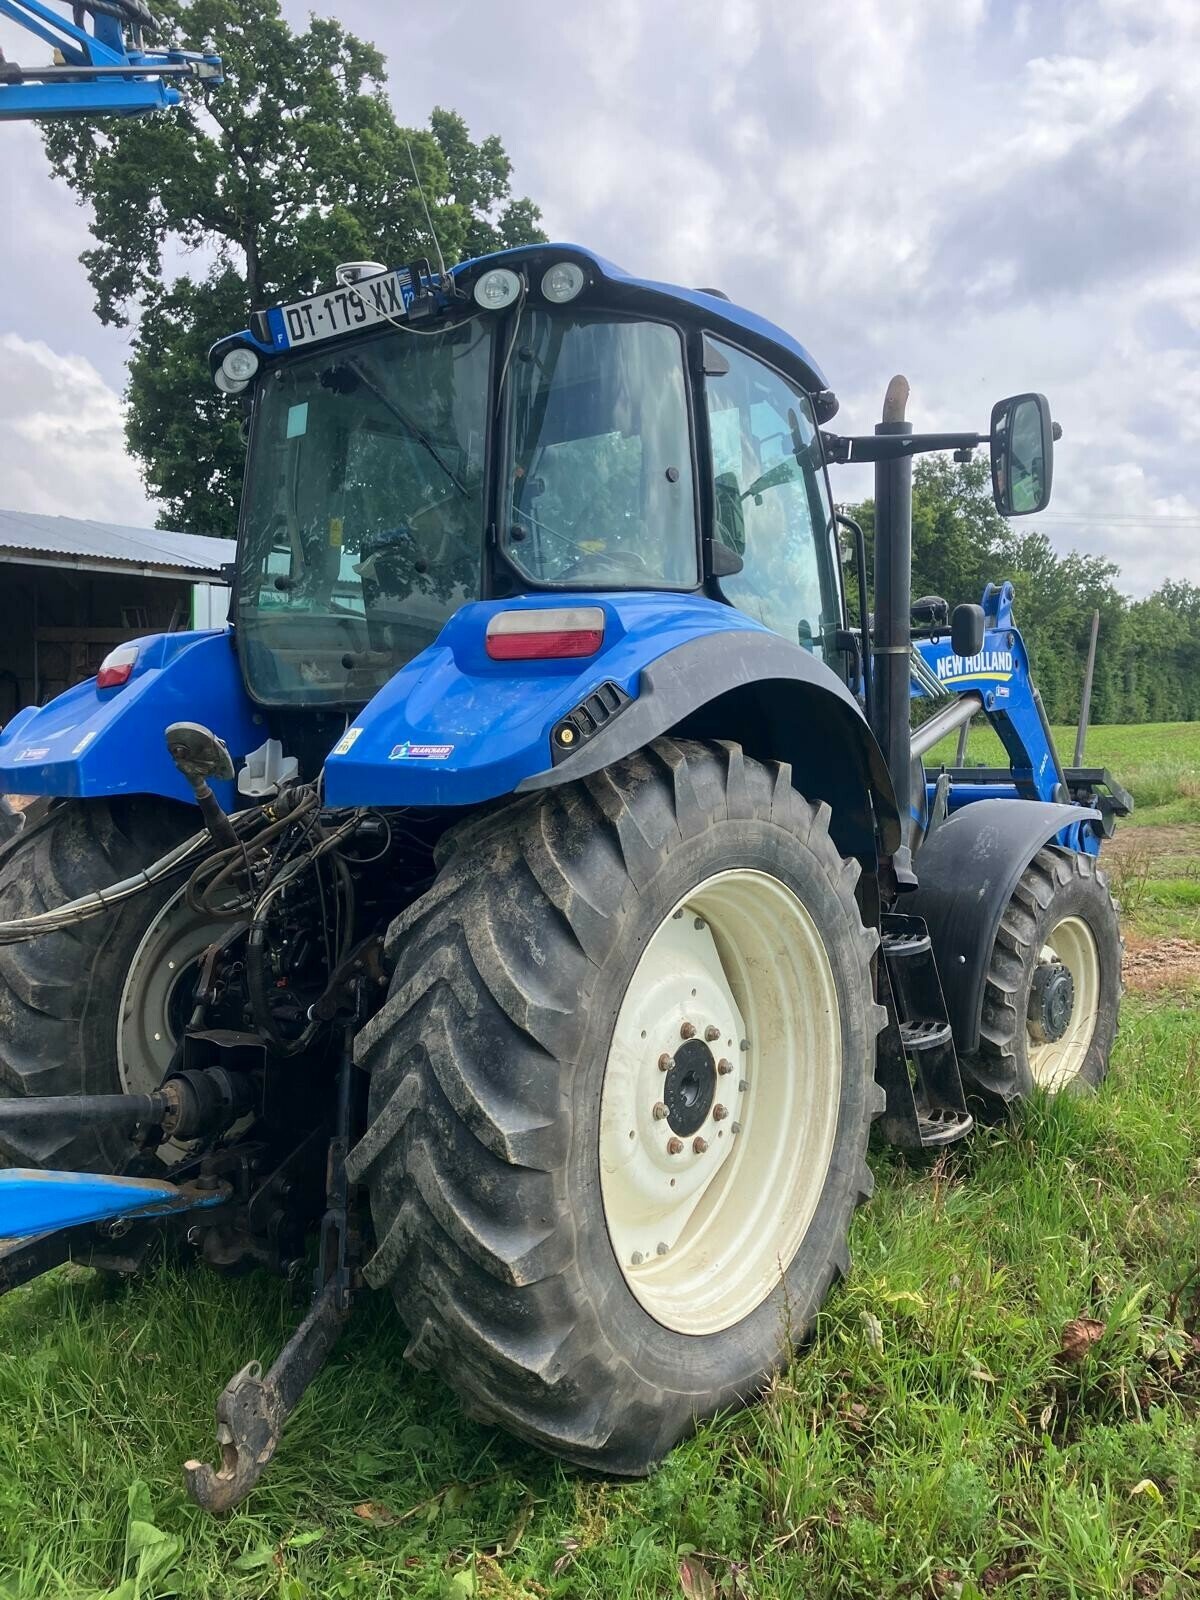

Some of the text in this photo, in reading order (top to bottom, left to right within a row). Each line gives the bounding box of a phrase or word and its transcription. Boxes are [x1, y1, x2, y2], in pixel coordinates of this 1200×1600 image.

[277, 334, 283, 344] F
[936, 651, 1012, 679] NEW HOLLAND
